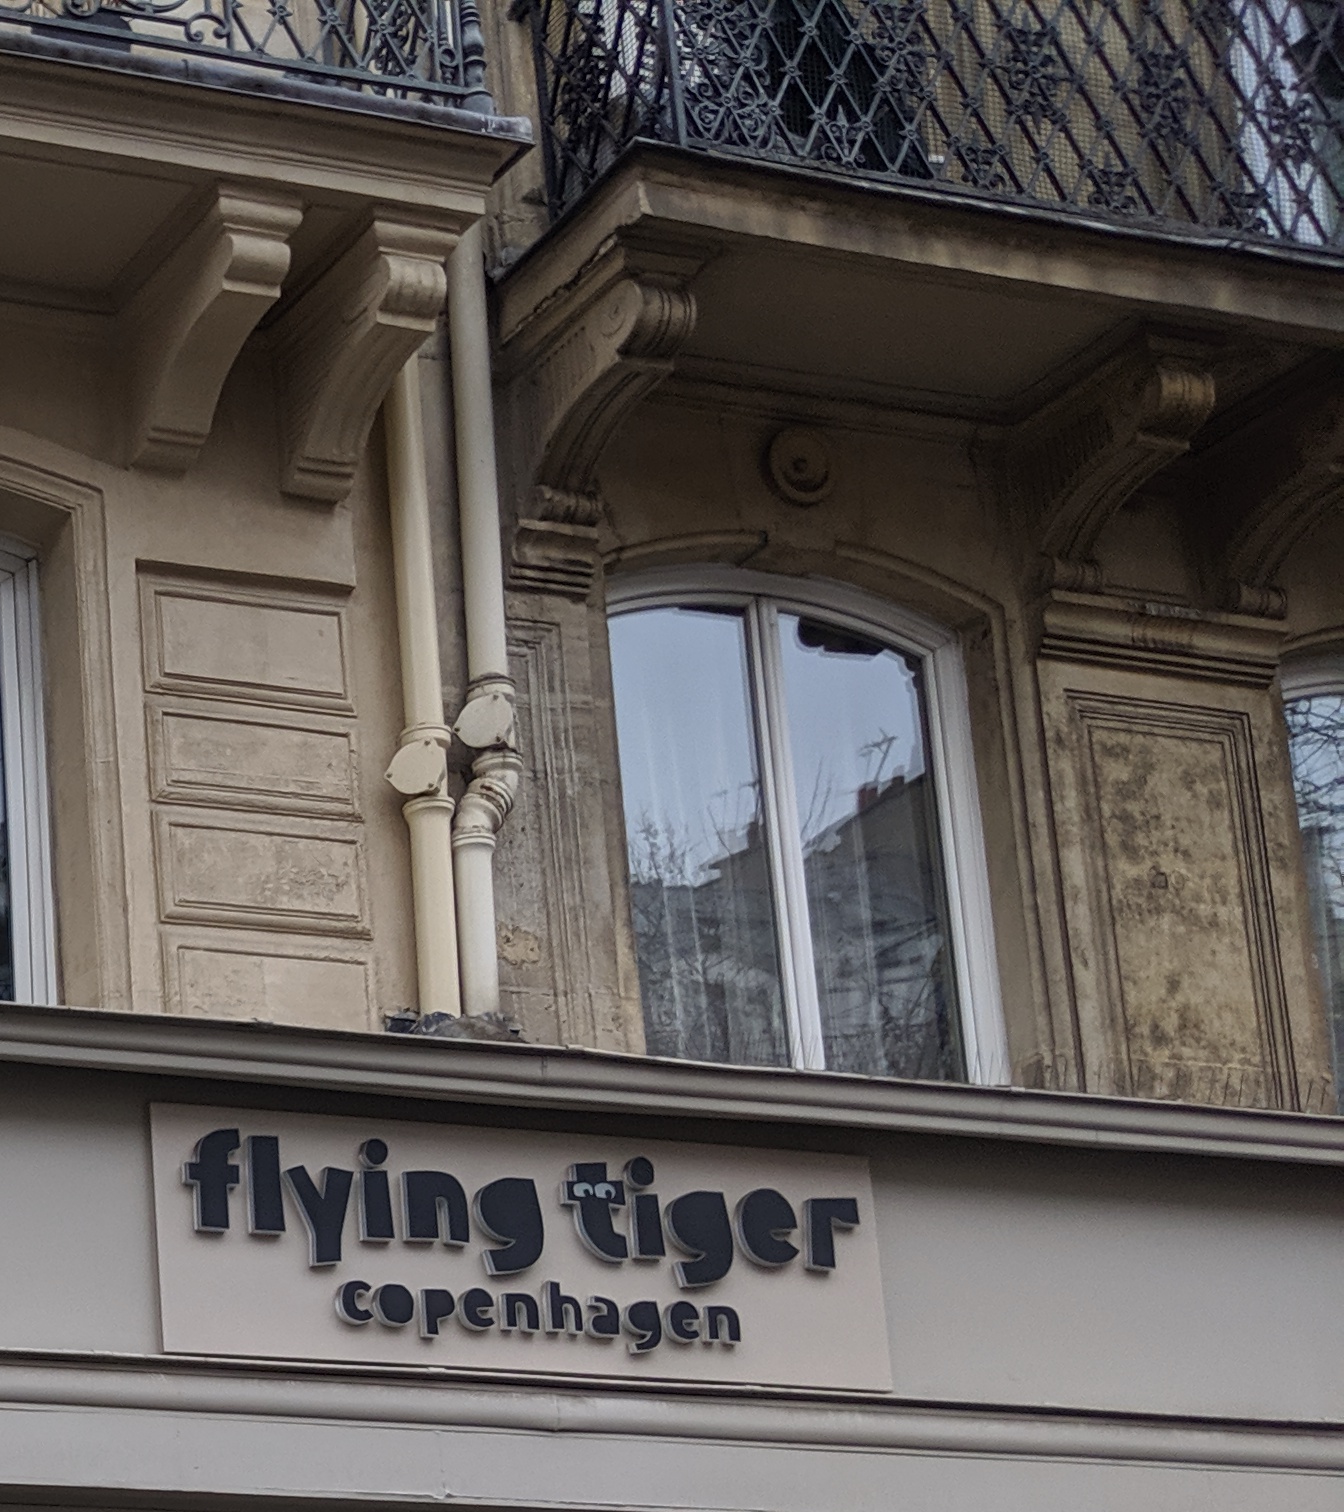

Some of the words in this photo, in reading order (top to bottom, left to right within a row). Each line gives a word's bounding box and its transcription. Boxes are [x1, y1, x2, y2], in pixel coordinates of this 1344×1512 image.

[183, 1128, 545, 1277] flying
[560, 1156, 860, 1289] tiger
[336, 1279, 742, 1354] copenhagen
